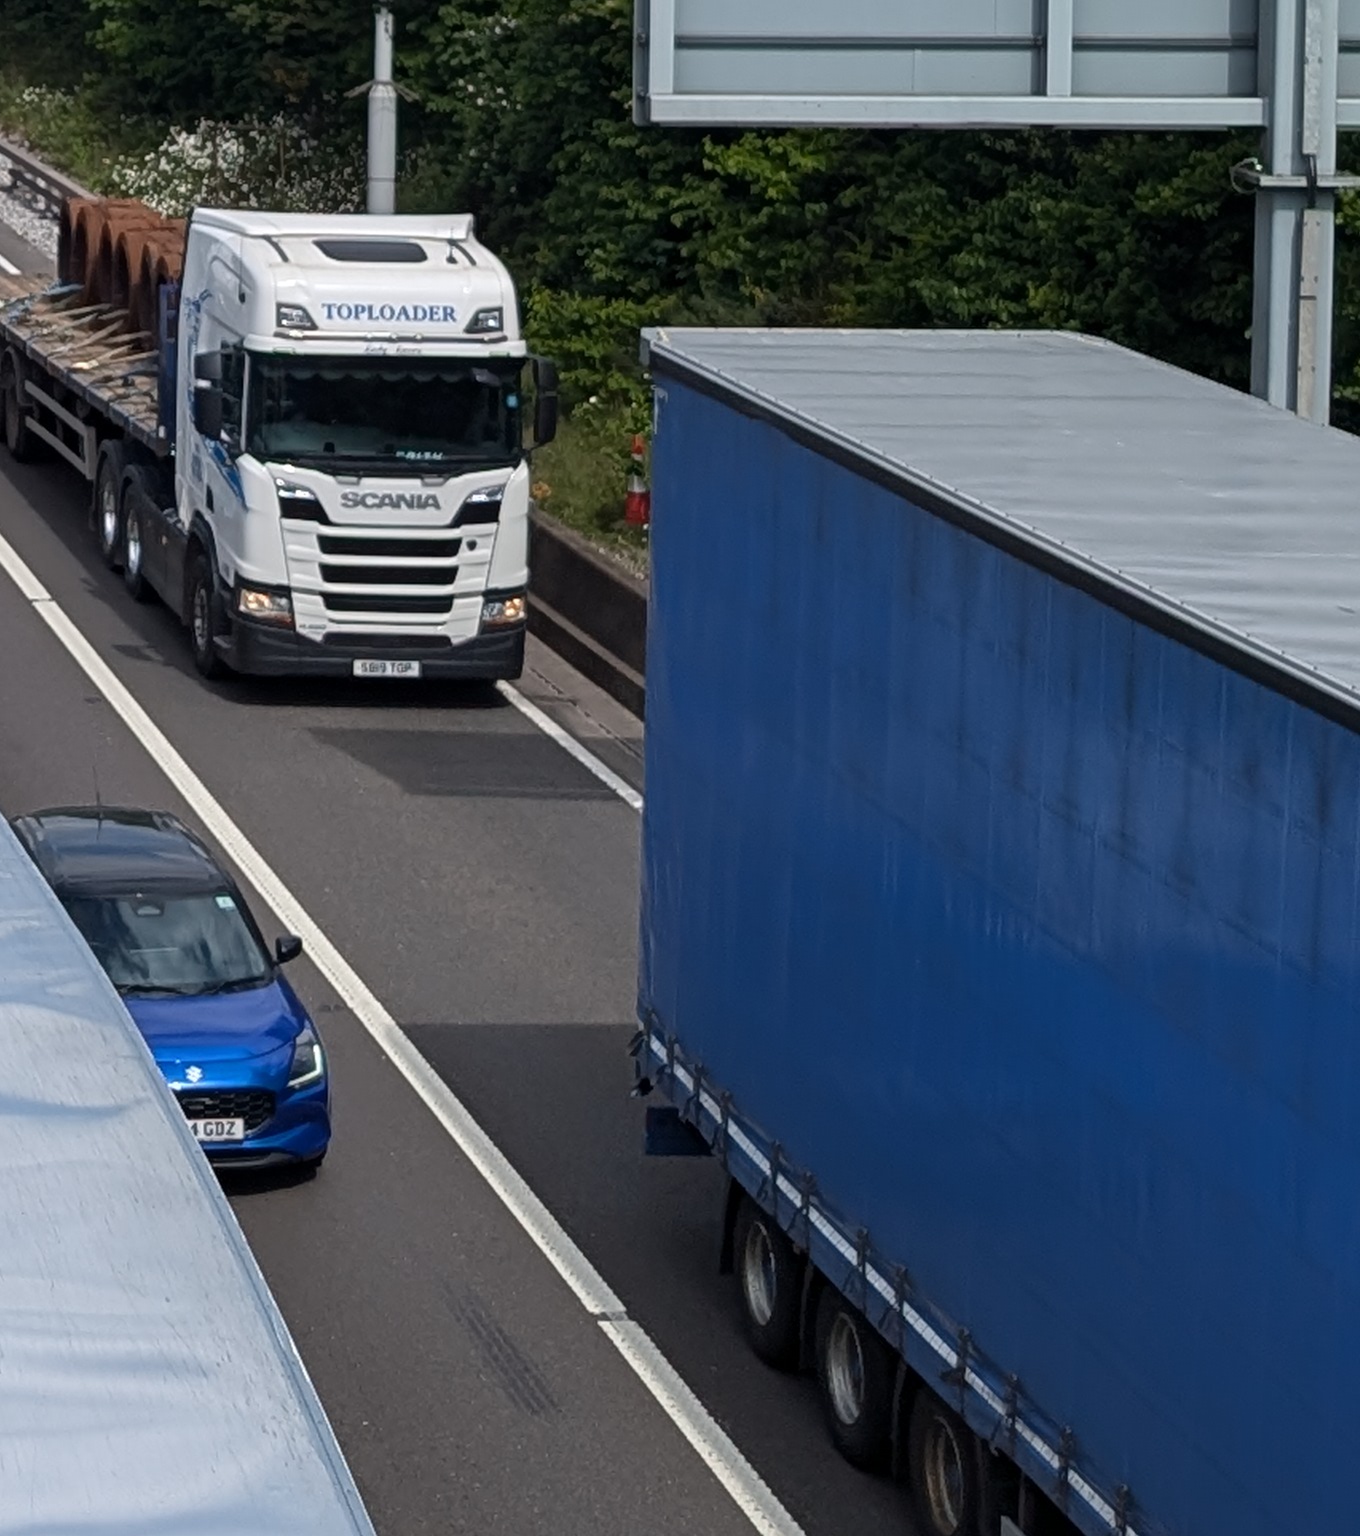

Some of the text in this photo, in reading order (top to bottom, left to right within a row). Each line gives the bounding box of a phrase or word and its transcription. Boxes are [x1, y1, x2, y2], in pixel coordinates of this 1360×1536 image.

[321, 302, 458, 323] TOPLOADER
[340, 491, 442, 510] SCANIA
[203, 1121, 236, 1137] GDZ
